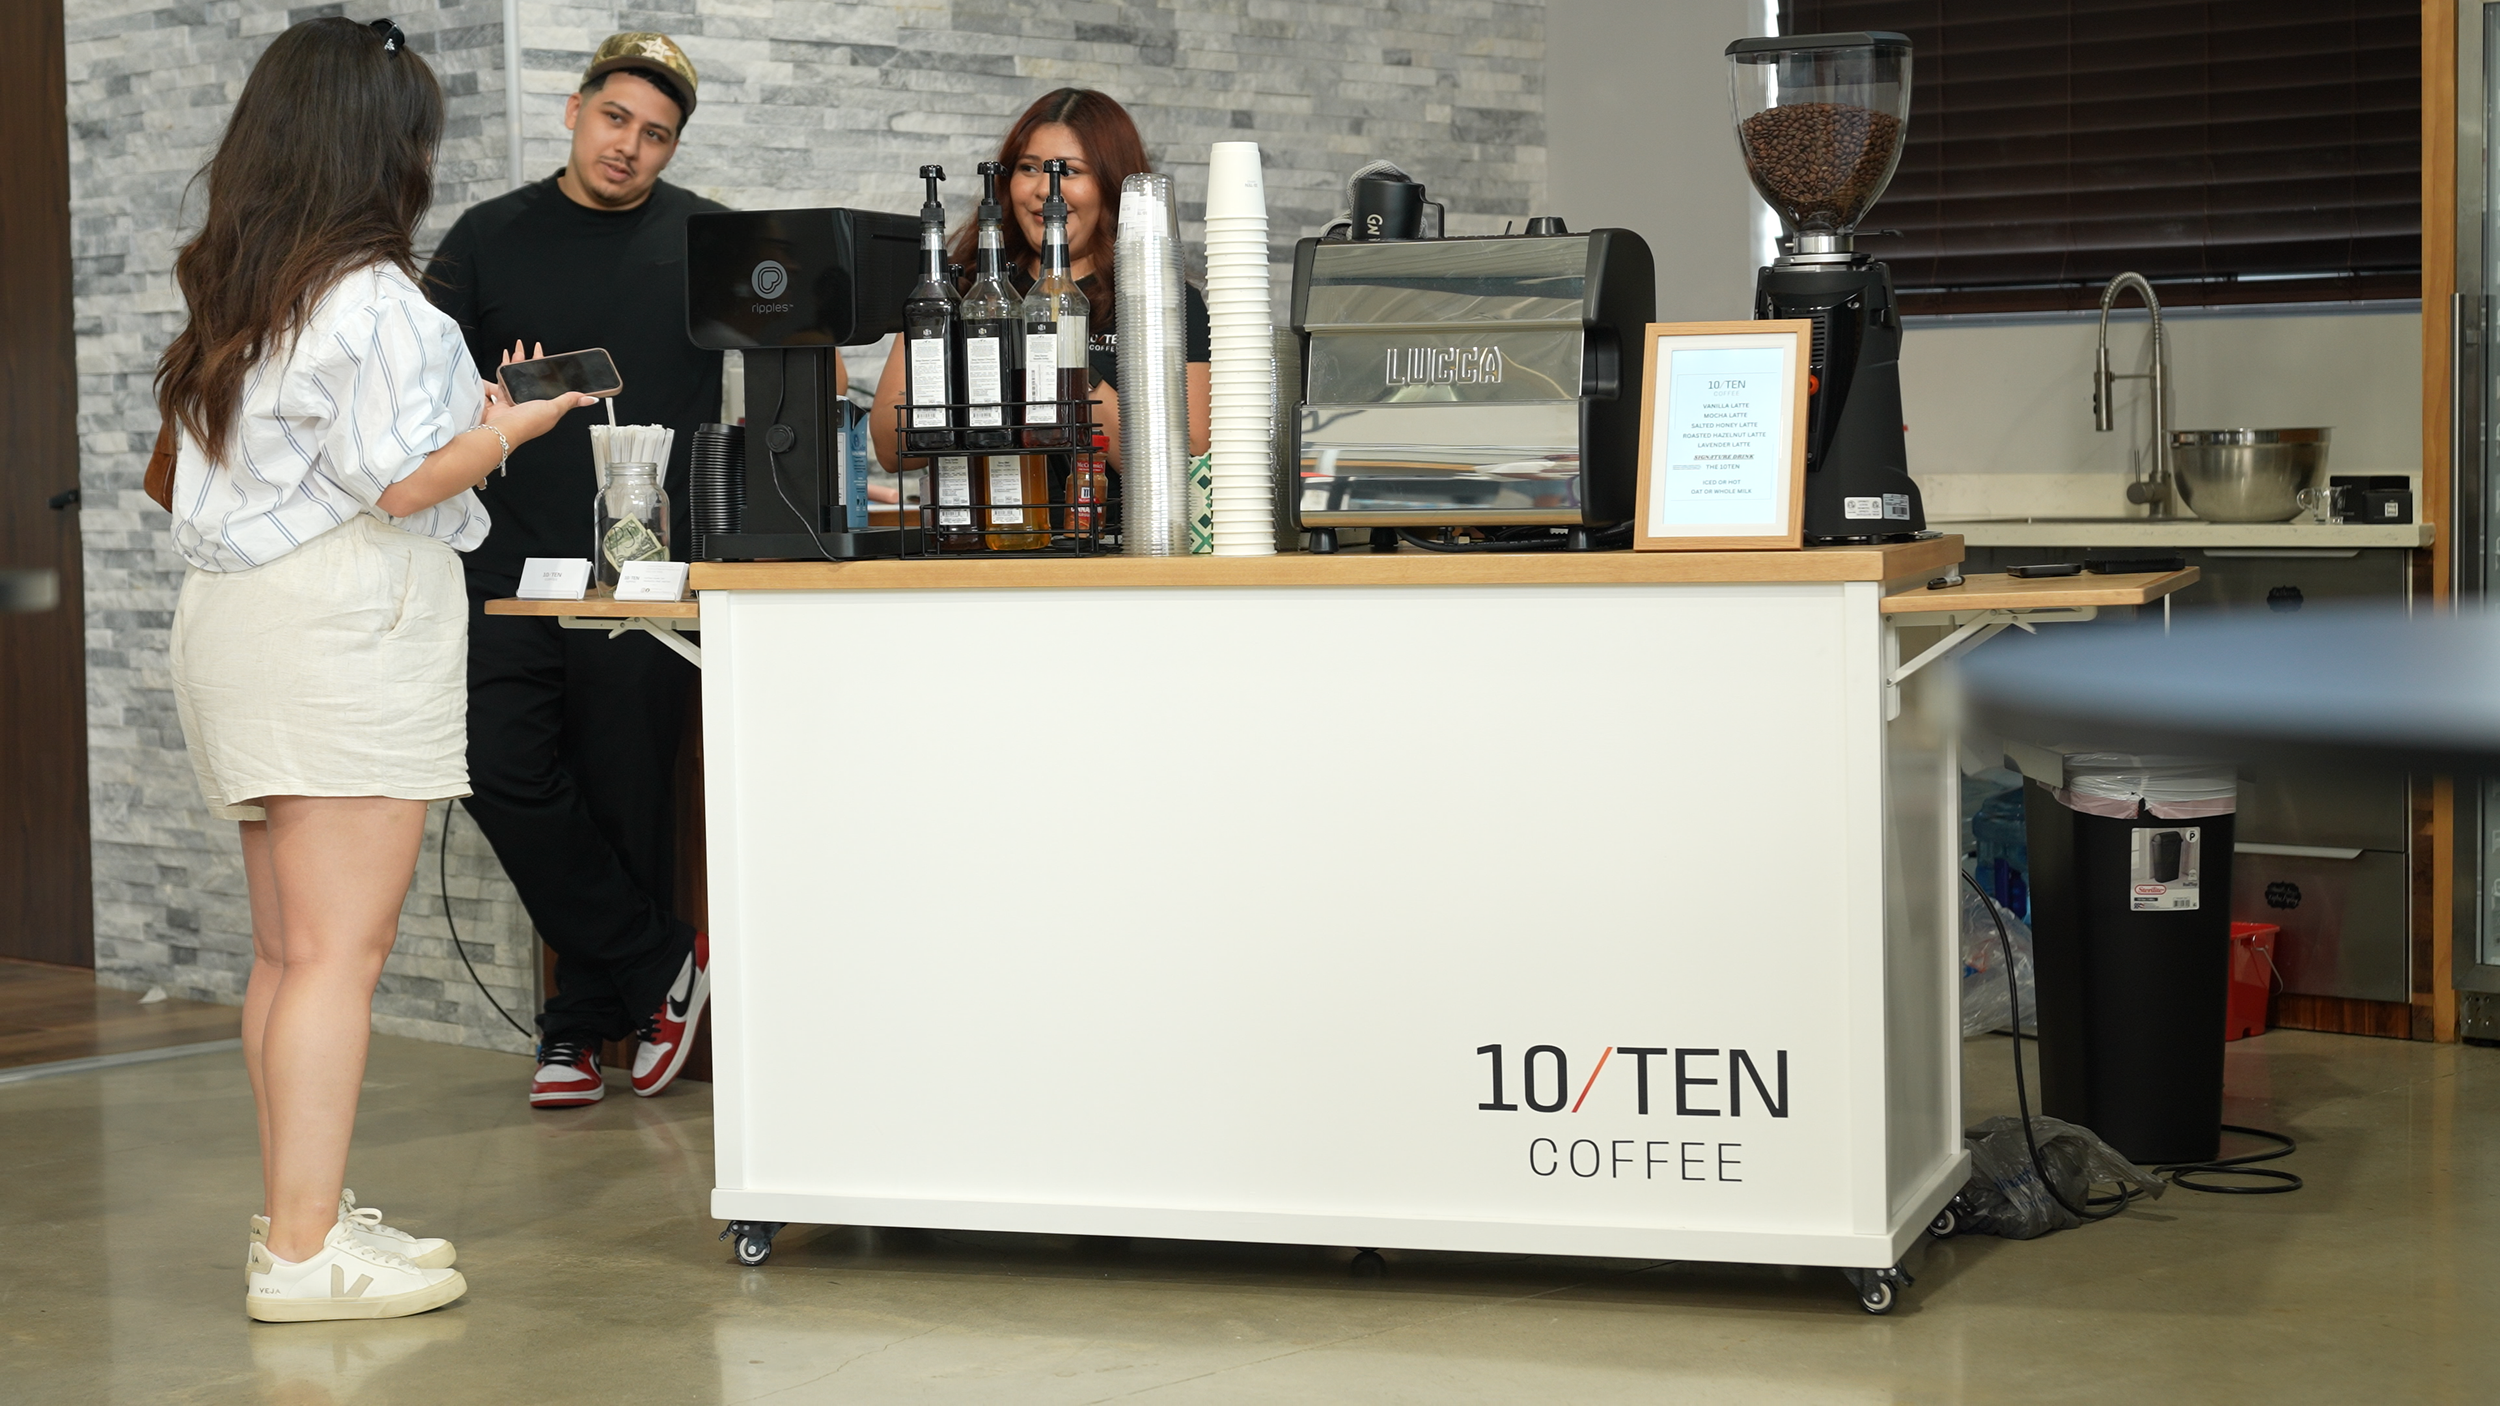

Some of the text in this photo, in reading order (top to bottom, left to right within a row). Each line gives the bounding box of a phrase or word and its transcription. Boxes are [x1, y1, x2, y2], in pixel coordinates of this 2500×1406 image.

[1088, 344, 1115, 353] COFFE
[1386, 346, 1503, 385] LUCCA
[1708, 380, 1746, 389] 10/TEN
[1476, 1042, 1789, 1118] 10/TEN
[1529, 1136, 1744, 1183] COFFEE
[259, 1287, 281, 1295] VEJA
